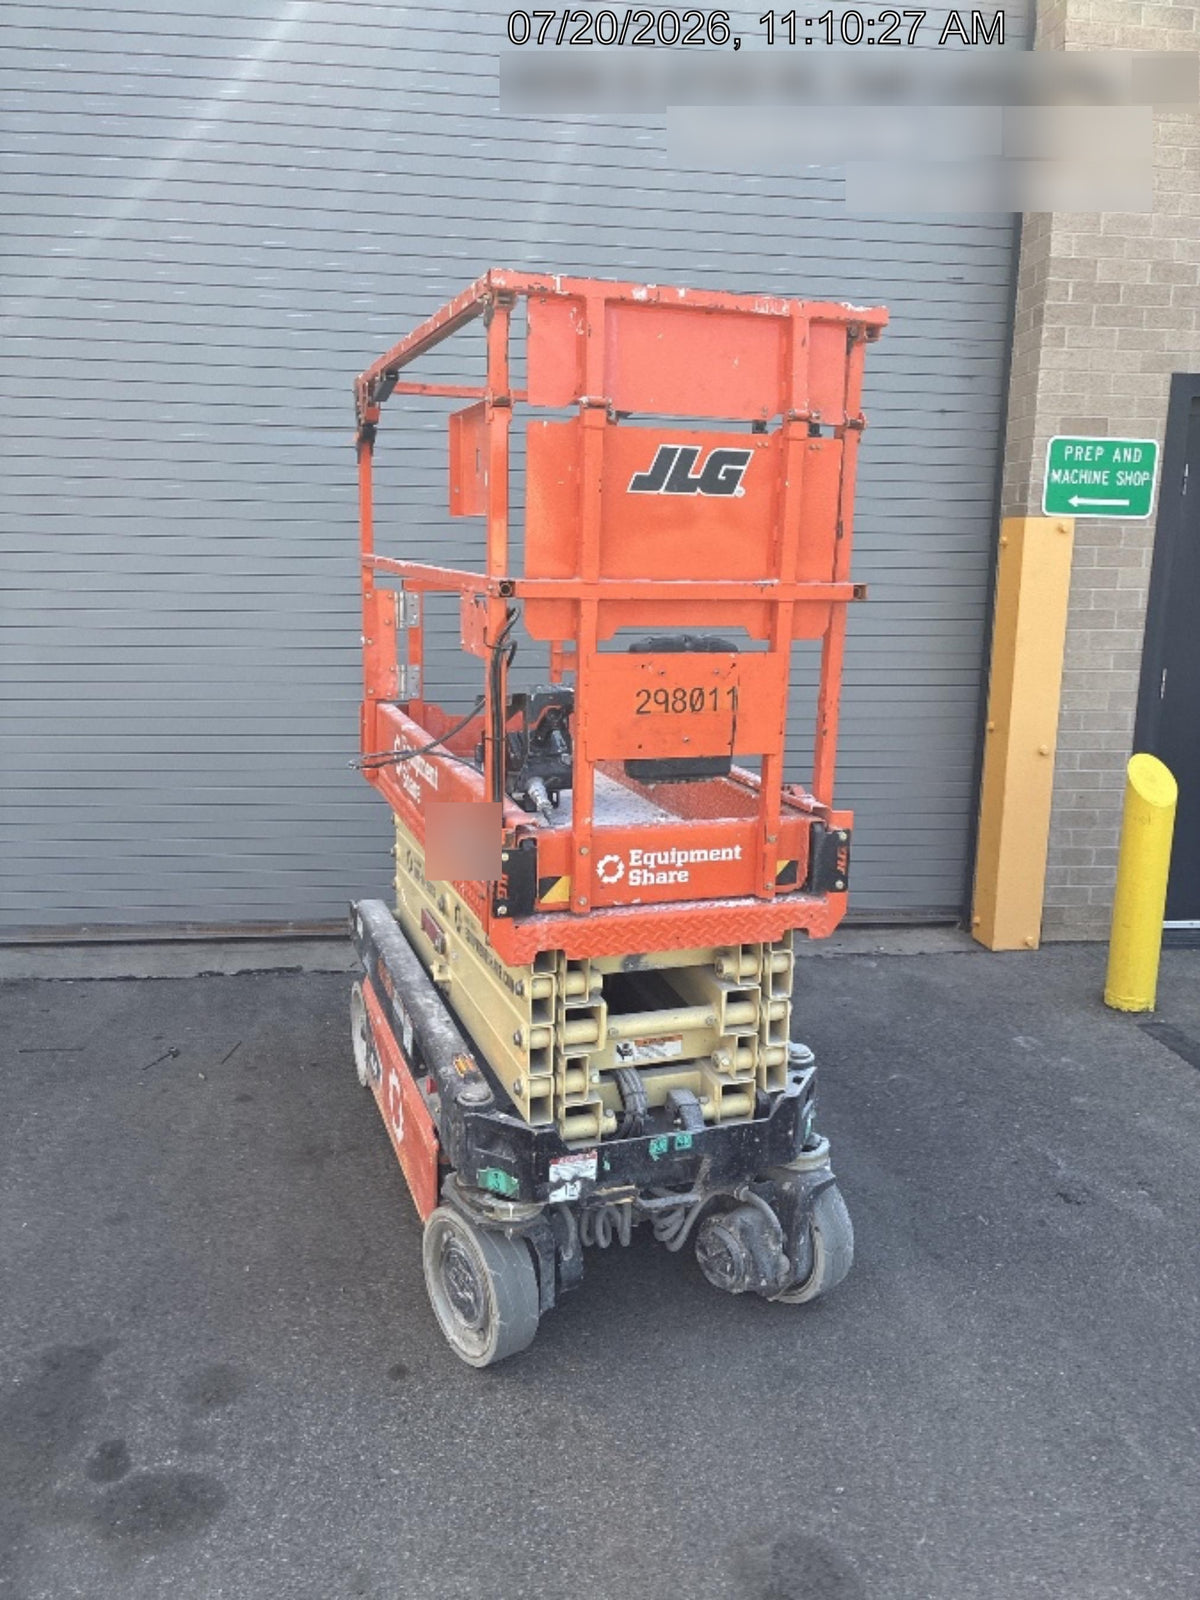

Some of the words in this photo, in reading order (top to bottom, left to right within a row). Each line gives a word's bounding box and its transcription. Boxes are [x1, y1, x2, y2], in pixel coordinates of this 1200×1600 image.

[1064, 445, 1105, 462] PREP
[1112, 447, 1143, 463] AND
[627, 444, 755, 497] JLG
[1050, 468, 1111, 486] MACHINE
[1116, 470, 1151, 487] SHOP
[635, 686, 739, 715] 298011
[628, 844, 742, 868] Equipment
[628, 868, 690, 887] Share
